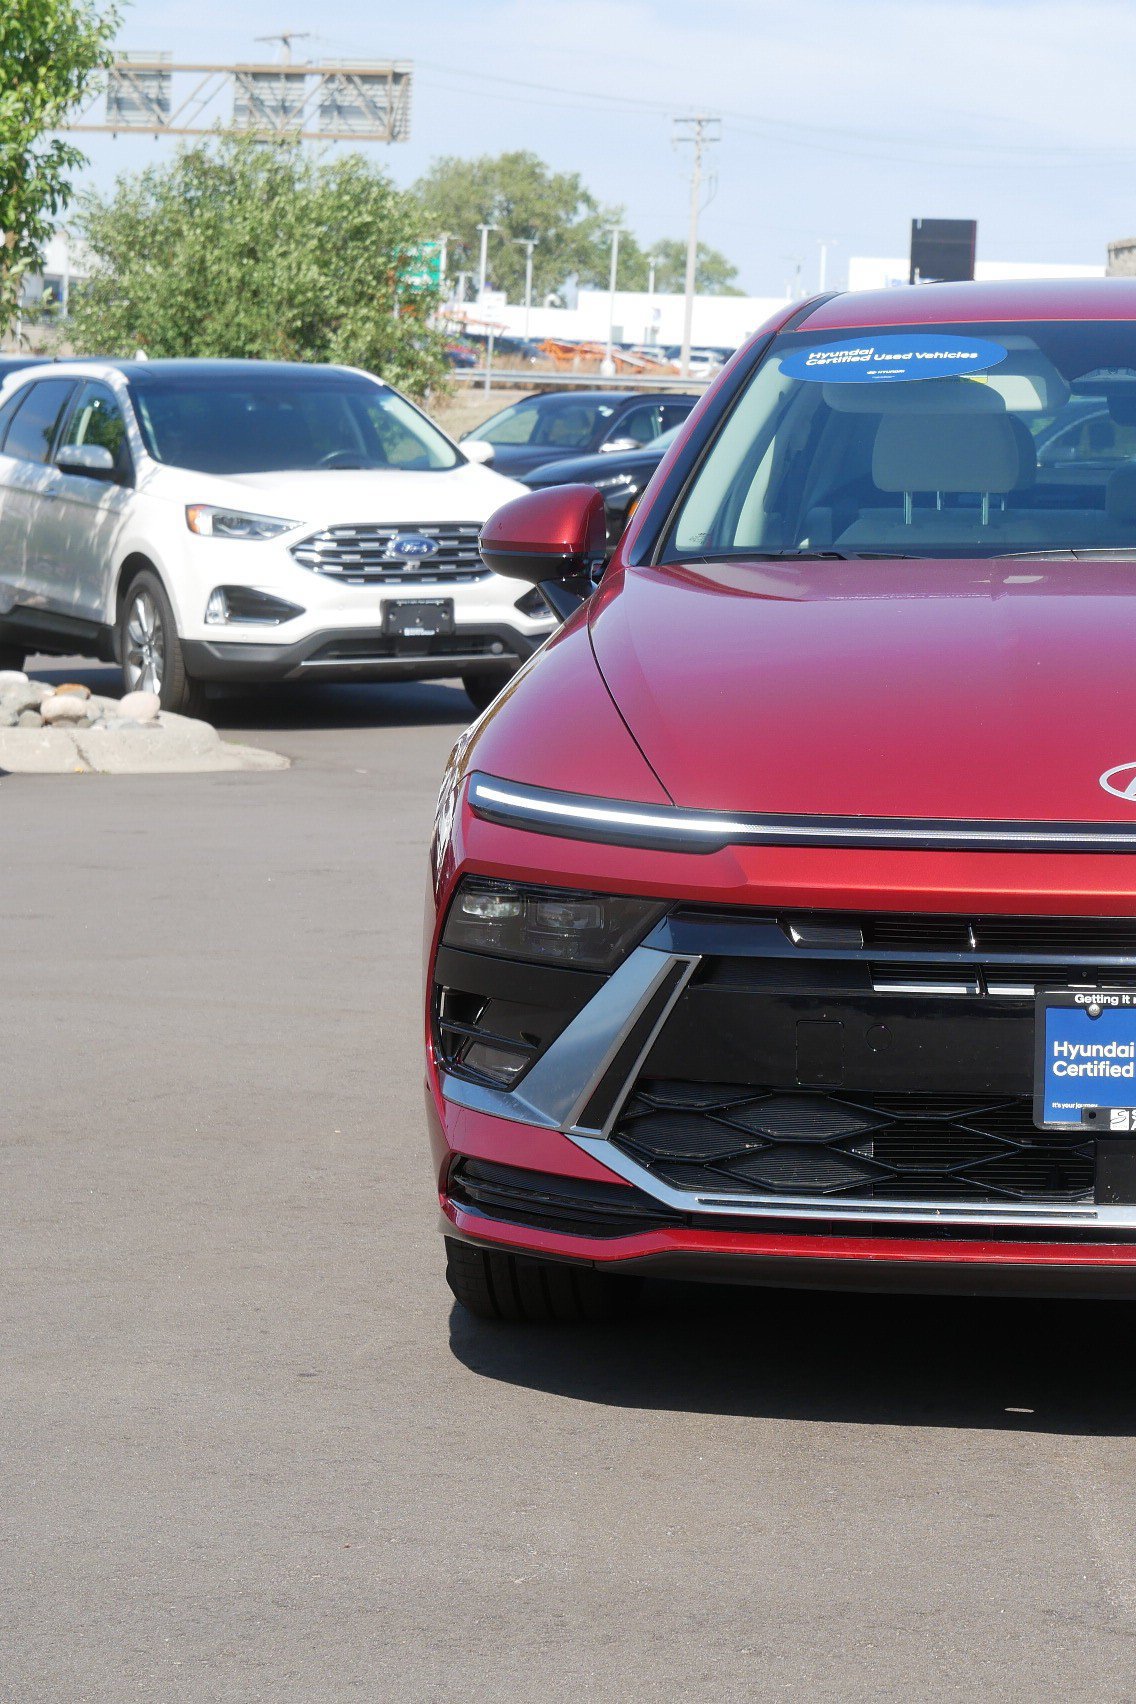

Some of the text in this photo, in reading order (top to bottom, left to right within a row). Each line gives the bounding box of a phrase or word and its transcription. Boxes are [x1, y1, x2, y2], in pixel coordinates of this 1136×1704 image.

[805, 351, 978, 366] Certified Used Vehicles
[808, 348, 875, 360] Hyundai
[1074, 994, 1119, 1006] Getting
[1122, 994, 1131, 1004] it
[1053, 1041, 1135, 1060] Hyundai
[1052, 1060, 1135, 1078] Certified
